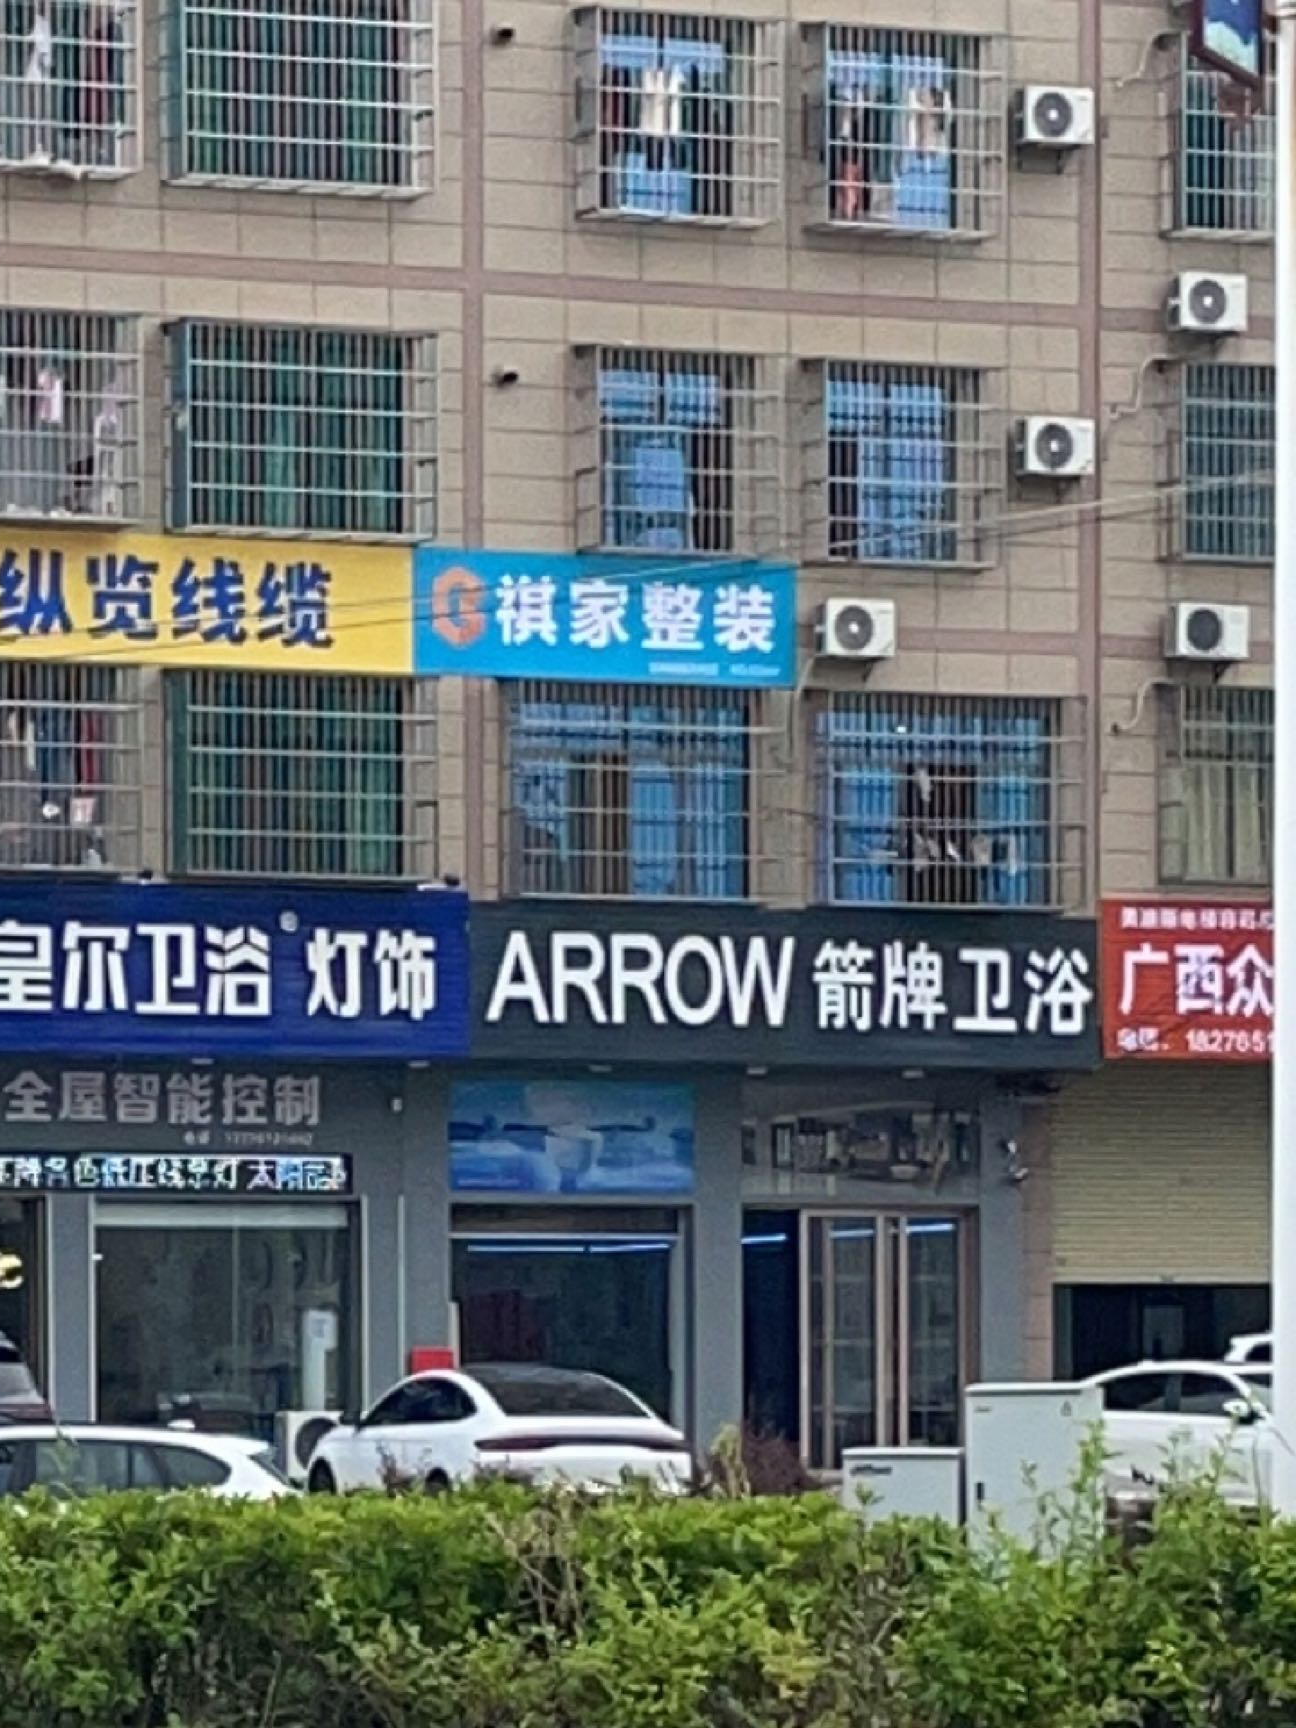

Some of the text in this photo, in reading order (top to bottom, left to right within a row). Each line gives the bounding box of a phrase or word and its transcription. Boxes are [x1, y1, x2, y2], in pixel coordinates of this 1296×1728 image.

[306, 928, 438, 1021] 灯饰
[486, 930, 1094, 1037] ARROW 箭牌卫浴
[1119, 942, 1275, 1018] 广西众
[3, 1070, 321, 1126] 全屋智能控制
